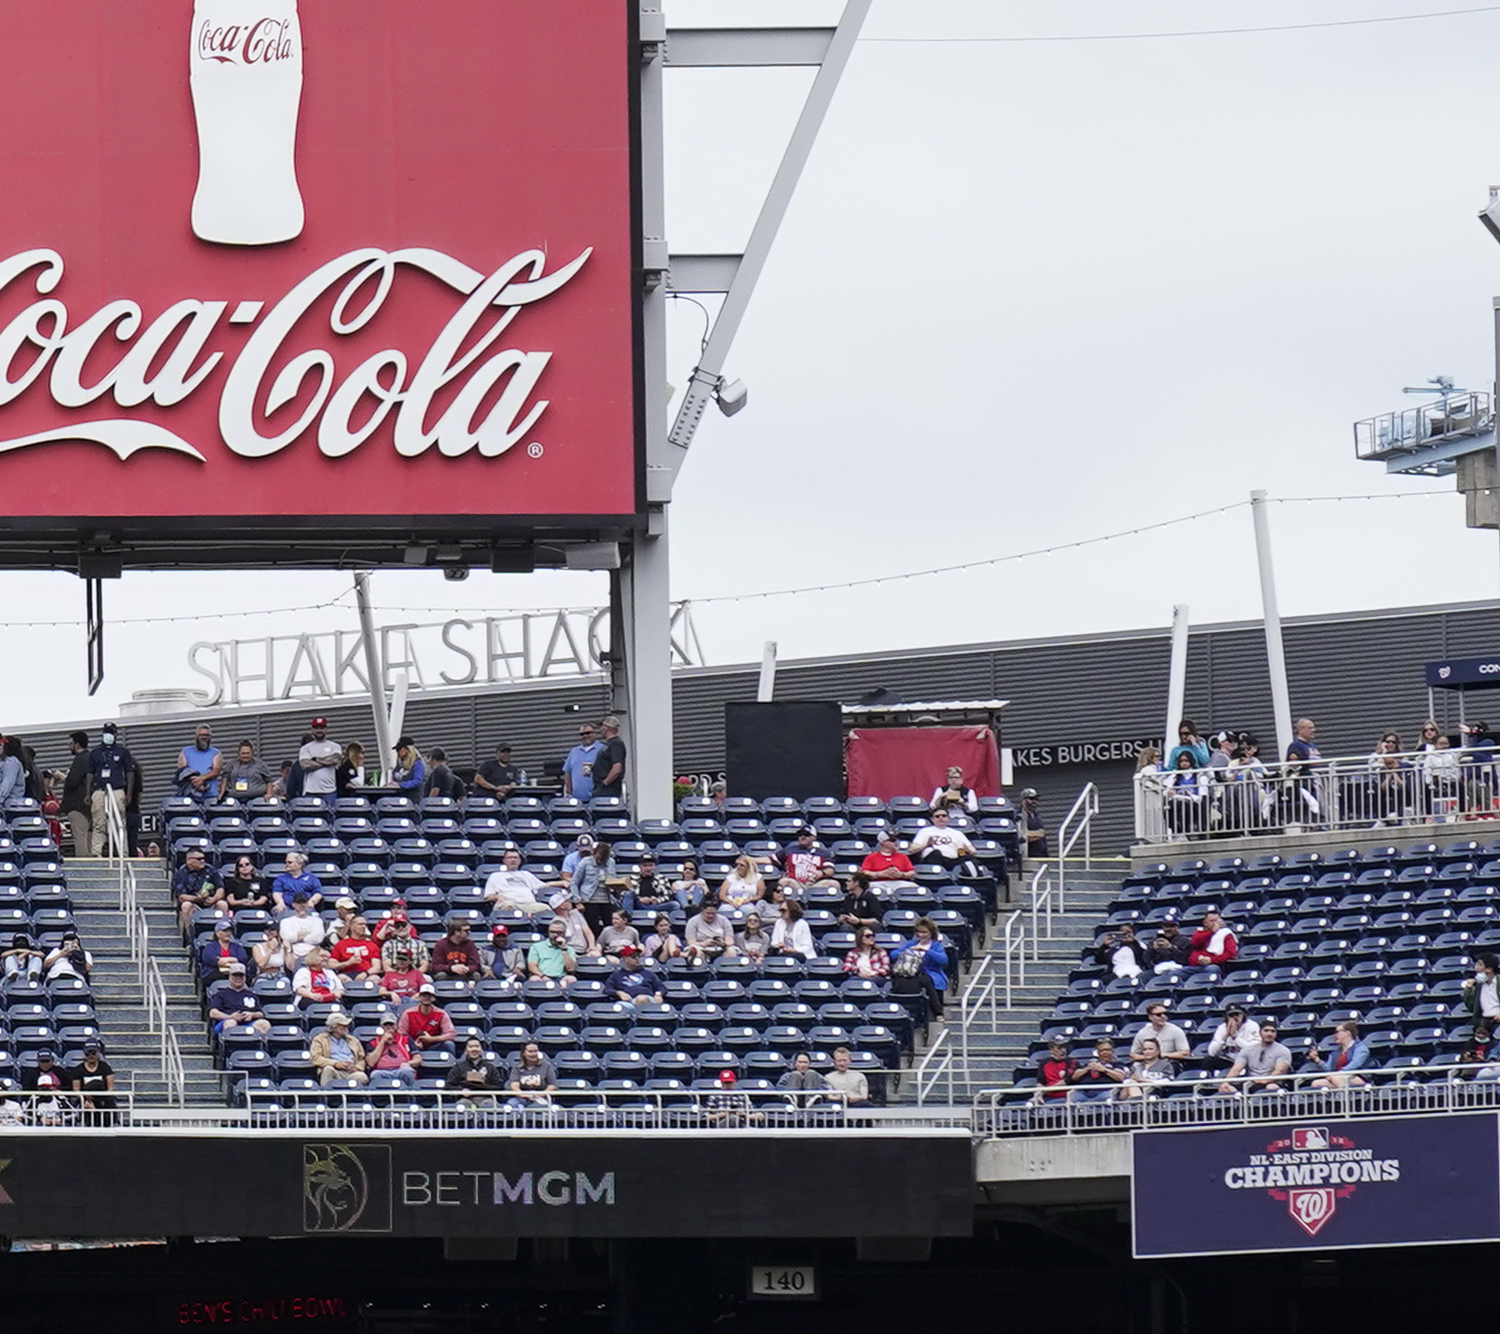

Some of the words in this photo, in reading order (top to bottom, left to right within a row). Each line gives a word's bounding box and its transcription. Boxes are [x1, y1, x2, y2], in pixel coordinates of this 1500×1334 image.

[196, 16, 296, 66] Coca-Cola
[184, 622, 422, 709] SHAKE
[1057, 741, 1144, 764] BURGERS
[1310, 1148, 1373, 1164] DIVISION
[401, 1171, 616, 1207] BETMGM
[1224, 1159, 1401, 1190] CHAMPIONS
[763, 1270, 805, 1292] 140
